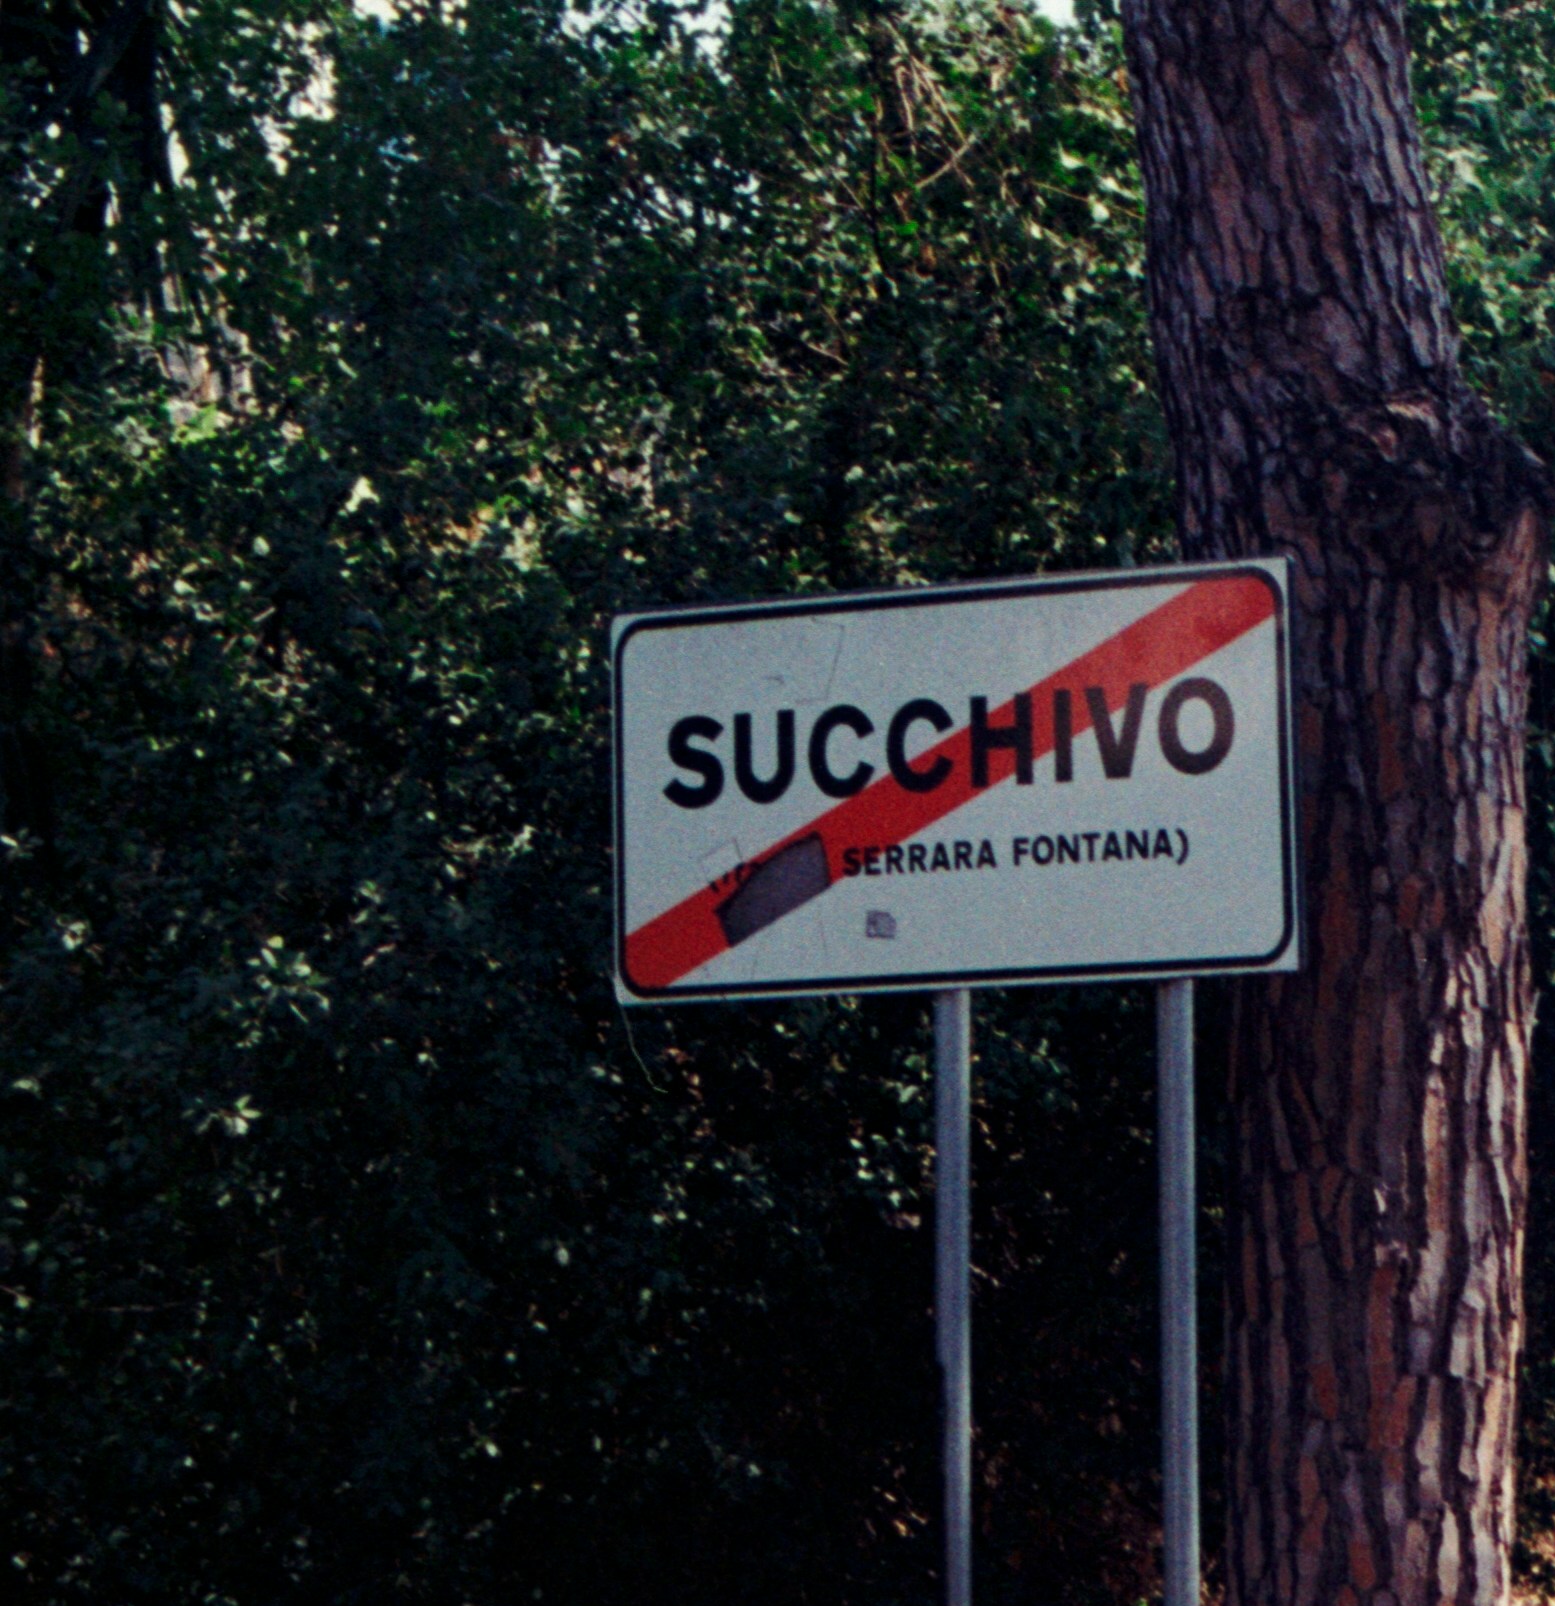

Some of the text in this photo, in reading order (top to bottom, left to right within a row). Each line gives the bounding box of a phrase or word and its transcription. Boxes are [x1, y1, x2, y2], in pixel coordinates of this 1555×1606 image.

[662, 677, 1235, 810] SUCCHIVO
[842, 828, 1190, 878] SERRARA FONTANA)
